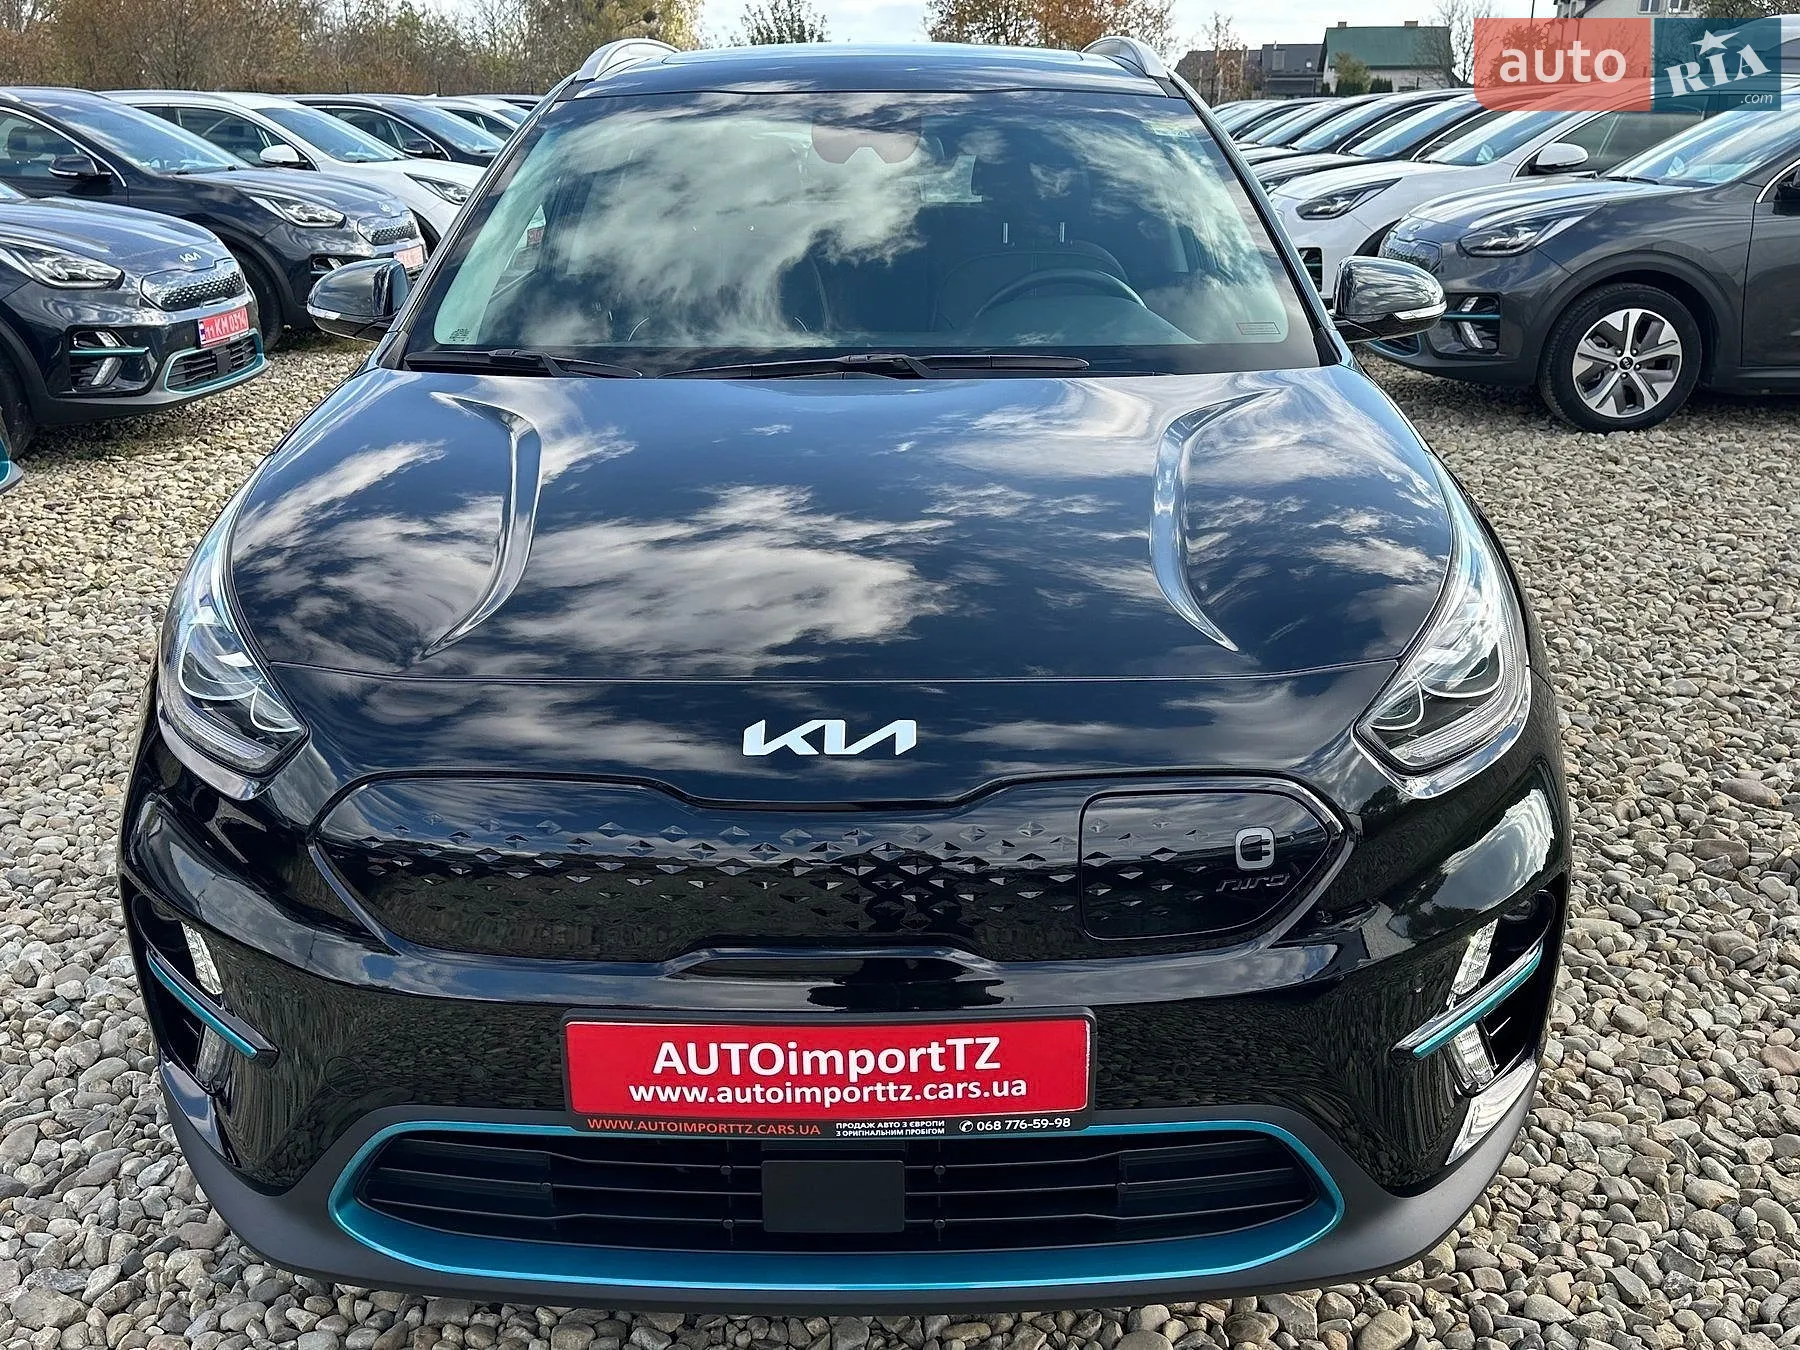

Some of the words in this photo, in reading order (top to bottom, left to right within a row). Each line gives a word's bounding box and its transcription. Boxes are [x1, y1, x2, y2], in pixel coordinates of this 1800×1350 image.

[743, 719, 917, 756] KIA
[652, 1036, 1001, 1083] AUTOimportTZ
[629, 1078, 1028, 1108] www.autoimporttz.cars.ua
[587, 1118, 821, 1136] WWW.AUTOIMPORTTZ.CARS.UA
[836, 1121, 876, 1129] ПРОДАЖ
[877, 1121, 900, 1129] АВТО
[909, 1120, 945, 1128] ЄВРОПИ
[905, 1128, 945, 1136] ПРОБІГОМ
[976, 1120, 1002, 1131] 068
[1004, 1118, 1071, 1131] 776-59-98
